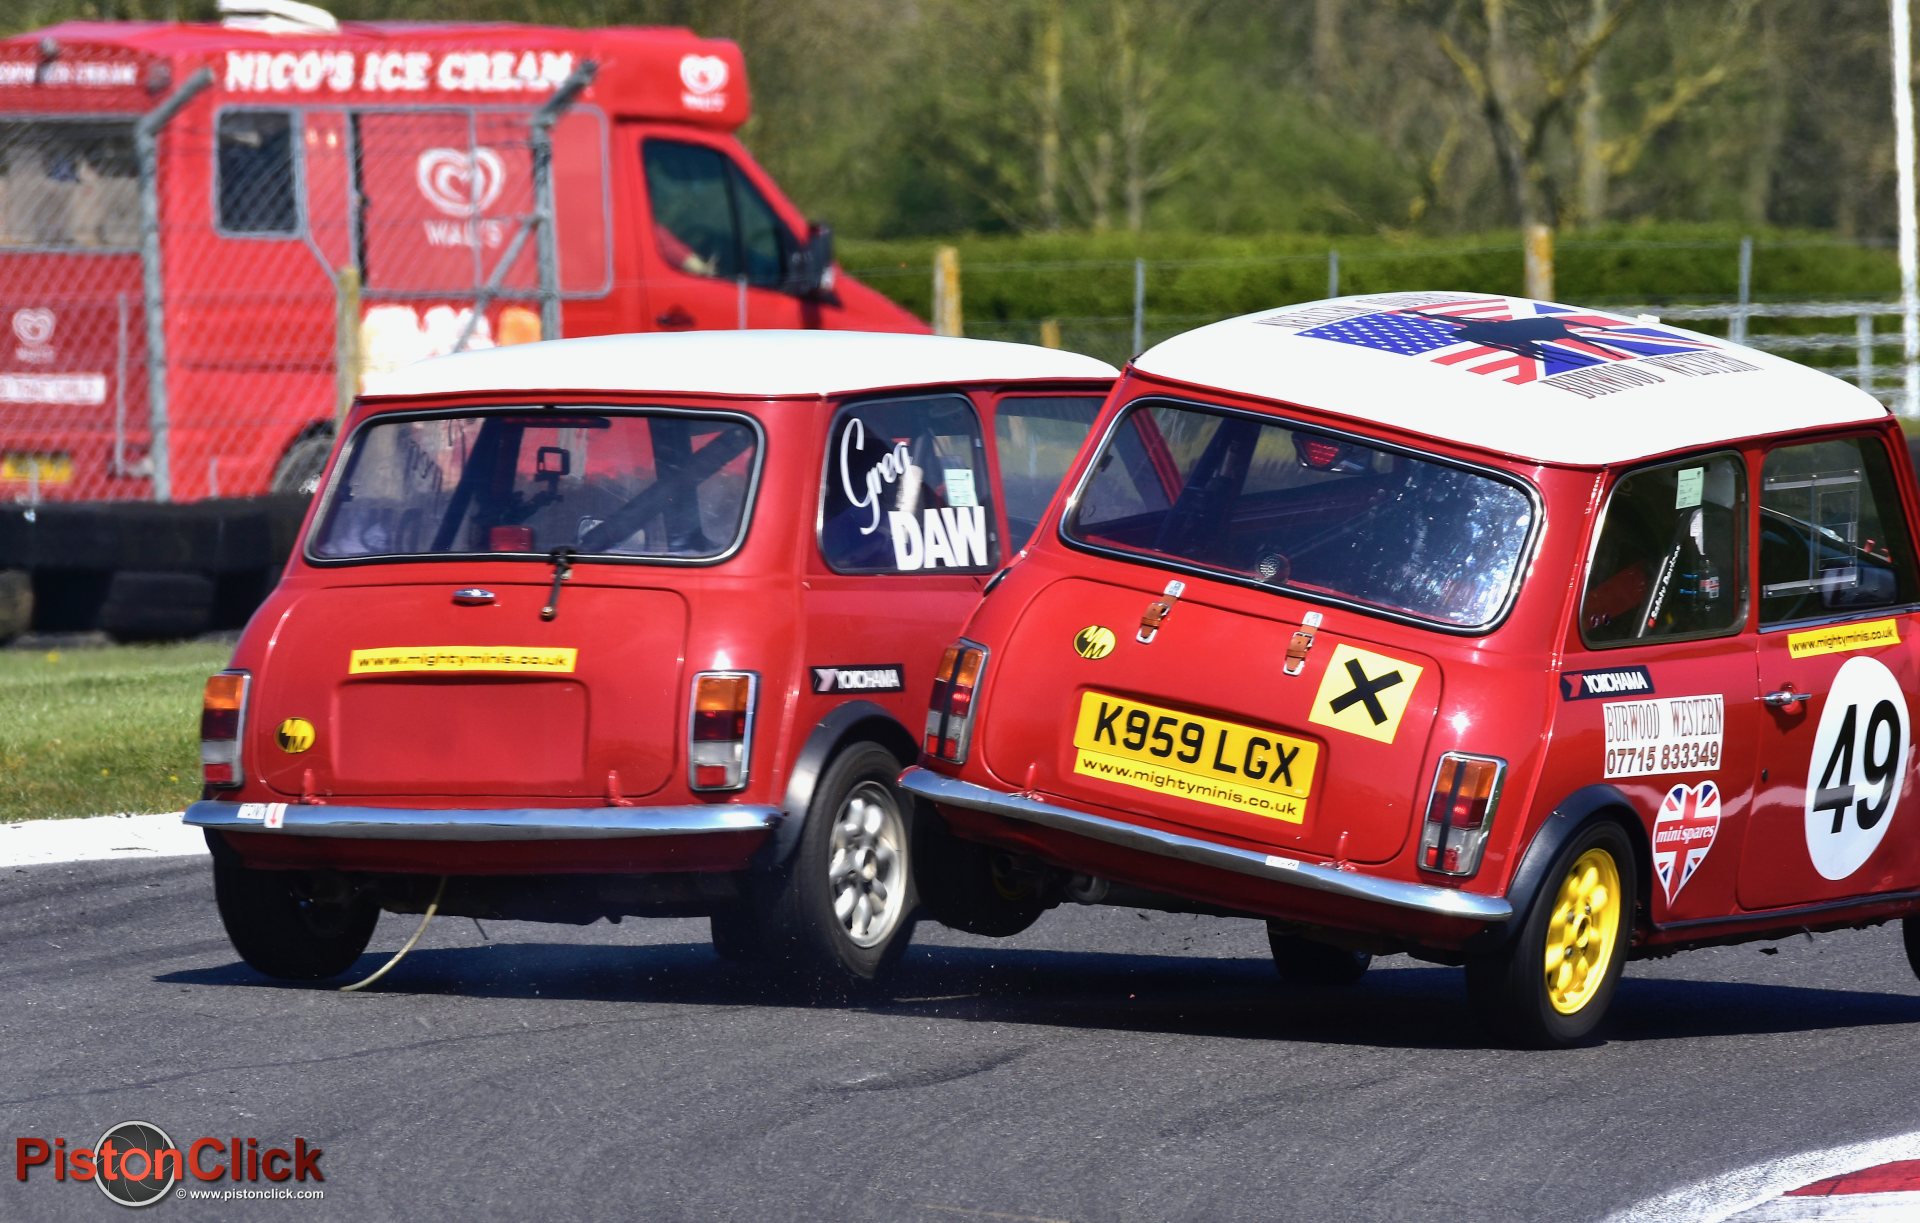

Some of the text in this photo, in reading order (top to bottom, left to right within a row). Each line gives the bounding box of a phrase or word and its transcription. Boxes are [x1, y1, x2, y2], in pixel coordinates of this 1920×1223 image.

[227, 51, 573, 91] NICO'S ICE CREAM
[1538, 363, 1665, 399] BURWOOD
[840, 418, 915, 535] Greg
[888, 506, 988, 571] DAW
[1791, 626, 1894, 651] www.mightyminis.co.uk
[357, 653, 568, 667] www.mightyminis.co.uk
[1583, 671, 1649, 693] YOKOHAMA
[1606, 697, 1722, 742] BURWOOD WESTERN
[1093, 701, 1300, 787] K959 LGX
[1606, 741, 1719, 774] 07715 833349
[1083, 758, 1297, 816] www.mightyminis.co.uk
[1813, 699, 1901, 834] 49
